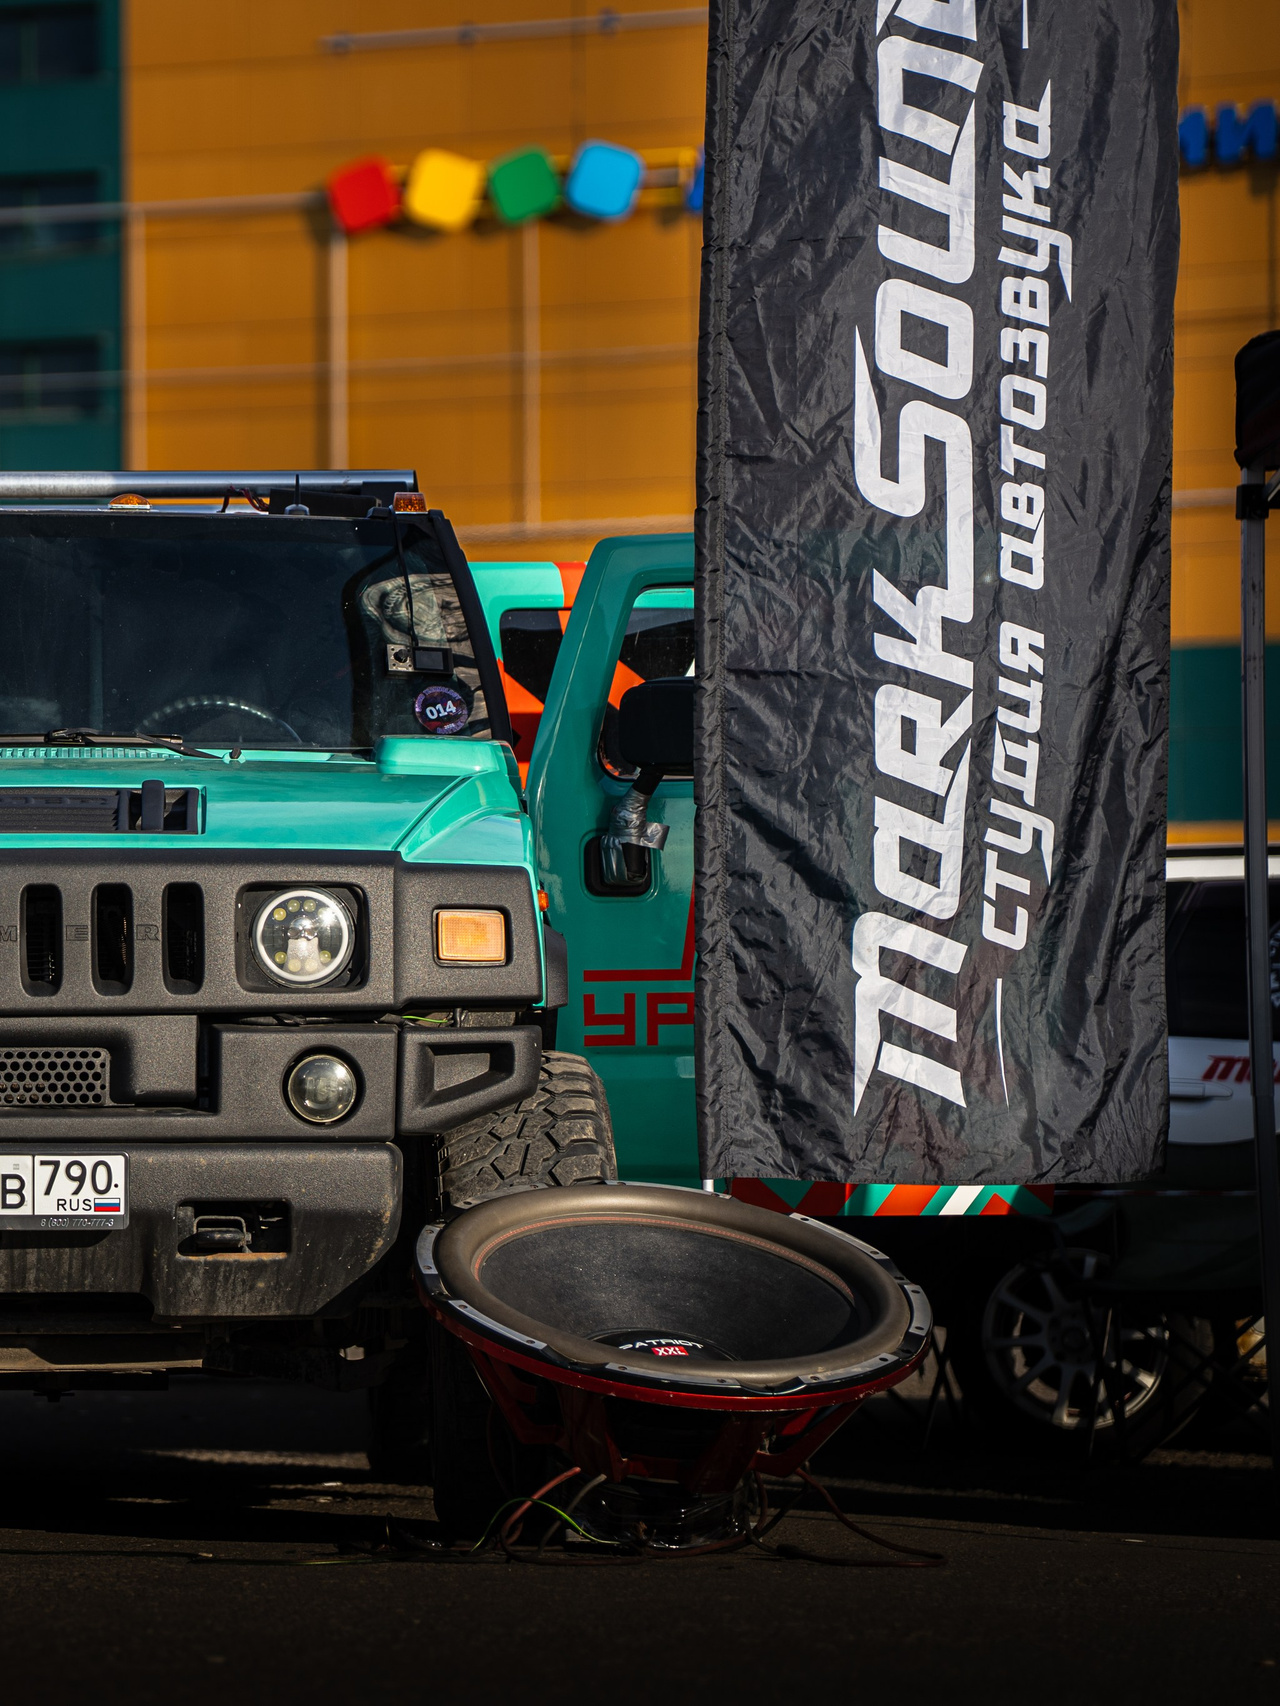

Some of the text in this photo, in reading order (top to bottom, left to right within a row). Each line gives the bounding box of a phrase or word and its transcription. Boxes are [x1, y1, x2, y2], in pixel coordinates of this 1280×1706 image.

[425, 700, 457, 720] 014
[40, 1160, 113, 1195] 790
[57, 1198, 92, 1211] RUS
[619, 1339, 704, 1350] PATRIOT
[655, 1345, 686, 1356] XXL
